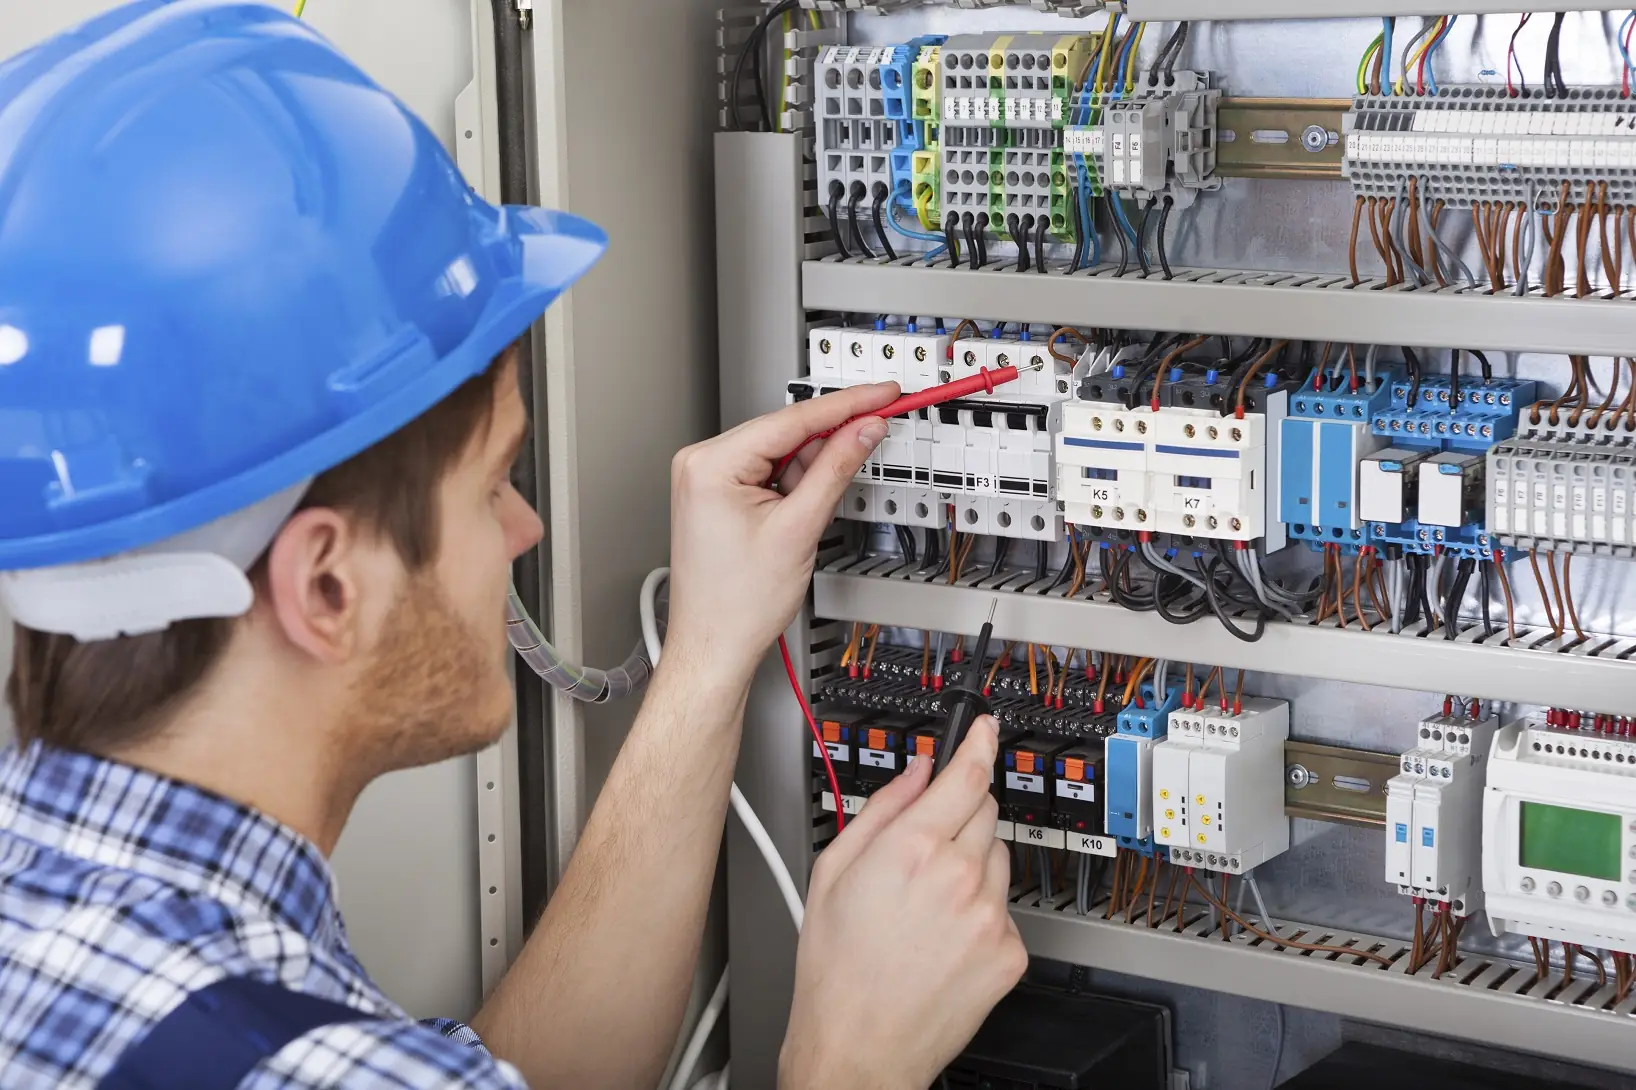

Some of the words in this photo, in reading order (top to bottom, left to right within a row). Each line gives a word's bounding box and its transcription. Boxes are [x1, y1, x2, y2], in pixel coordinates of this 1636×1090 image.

[1114, 141, 1121, 150] F4
[976, 477, 989, 487] F3
[1093, 489, 1108, 500] K5
[1184, 497, 1200, 509] K7
[1028, 828, 1043, 839] K6
[1081, 837, 1103, 850] K10
